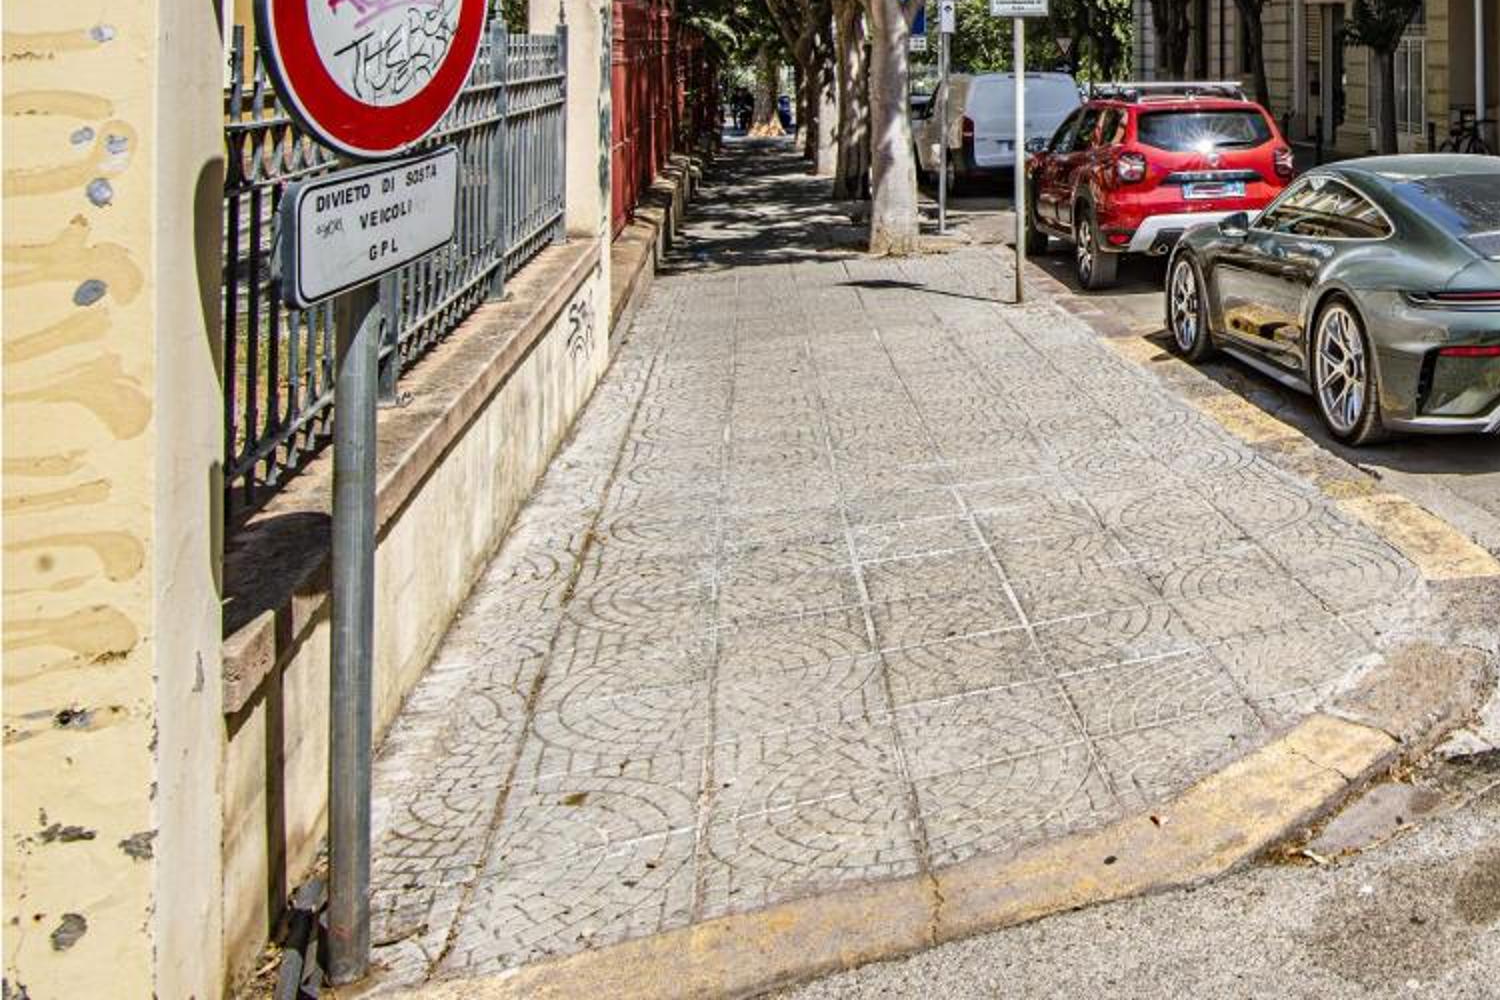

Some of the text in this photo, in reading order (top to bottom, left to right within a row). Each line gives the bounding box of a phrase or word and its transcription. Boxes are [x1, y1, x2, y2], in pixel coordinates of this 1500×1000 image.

[316, 164, 437, 213] DIVIETO DI SOSTA
[360, 199, 412, 230] VEICOLI
